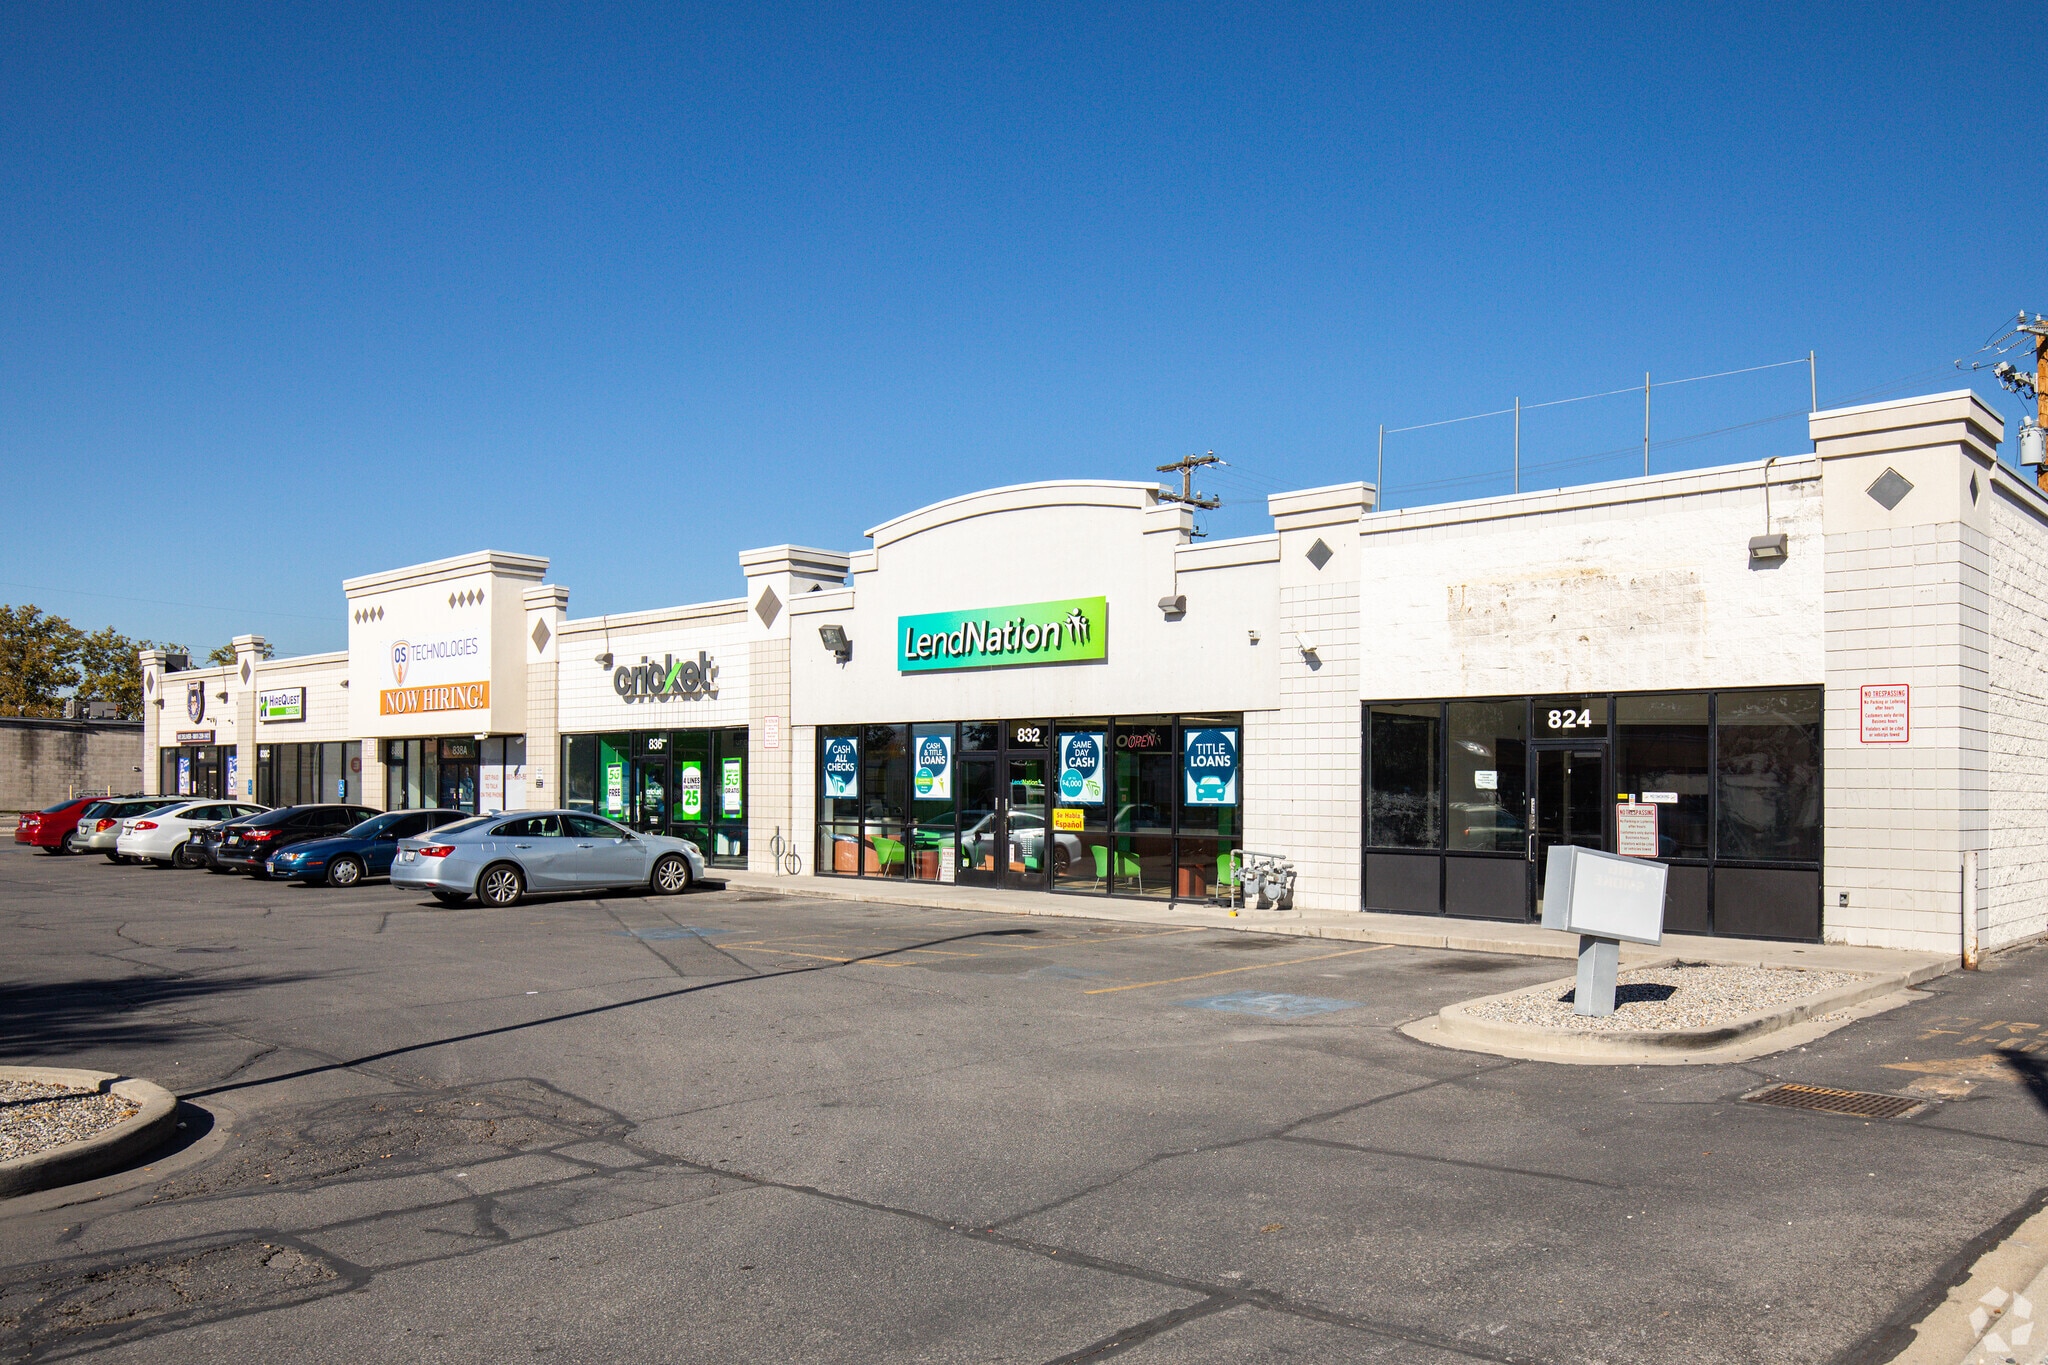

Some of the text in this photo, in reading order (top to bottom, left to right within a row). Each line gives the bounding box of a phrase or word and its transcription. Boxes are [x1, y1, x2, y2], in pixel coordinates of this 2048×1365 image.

[905, 617, 1060, 658] LendNation
[394, 637, 479, 663] OS TECHNOLOGIES
[614, 650, 711, 697] cricket
[1873, 689, 1906, 697] TRESPASSING
[385, 684, 484, 715] NOW HIRING!
[1548, 709, 1592, 728] 824
[1017, 728, 1040, 743] 832
[648, 738, 662, 750] 836
[1072, 740, 1092, 749] SAME
[1127, 735, 1155, 749] OPEN
[452, 745, 468, 755] 838A
[832, 745, 851, 754] CASH
[1074, 749, 1090, 757] DAY
[1196, 743, 1226, 755] TITLE
[834, 754, 848, 762] ALL
[920, 756, 946, 765] LOANS
[1068, 757, 1096, 768] CASH
[1190, 755, 1231, 768] LOANS
[827, 763, 855, 772] CHECKS
[608, 769, 620, 780] 5G
[725, 774, 738, 786] 5G
[1062, 780, 1082, 788] $4,000
[608, 788, 620, 797] FREE
[1055, 820, 1082, 829] Español
